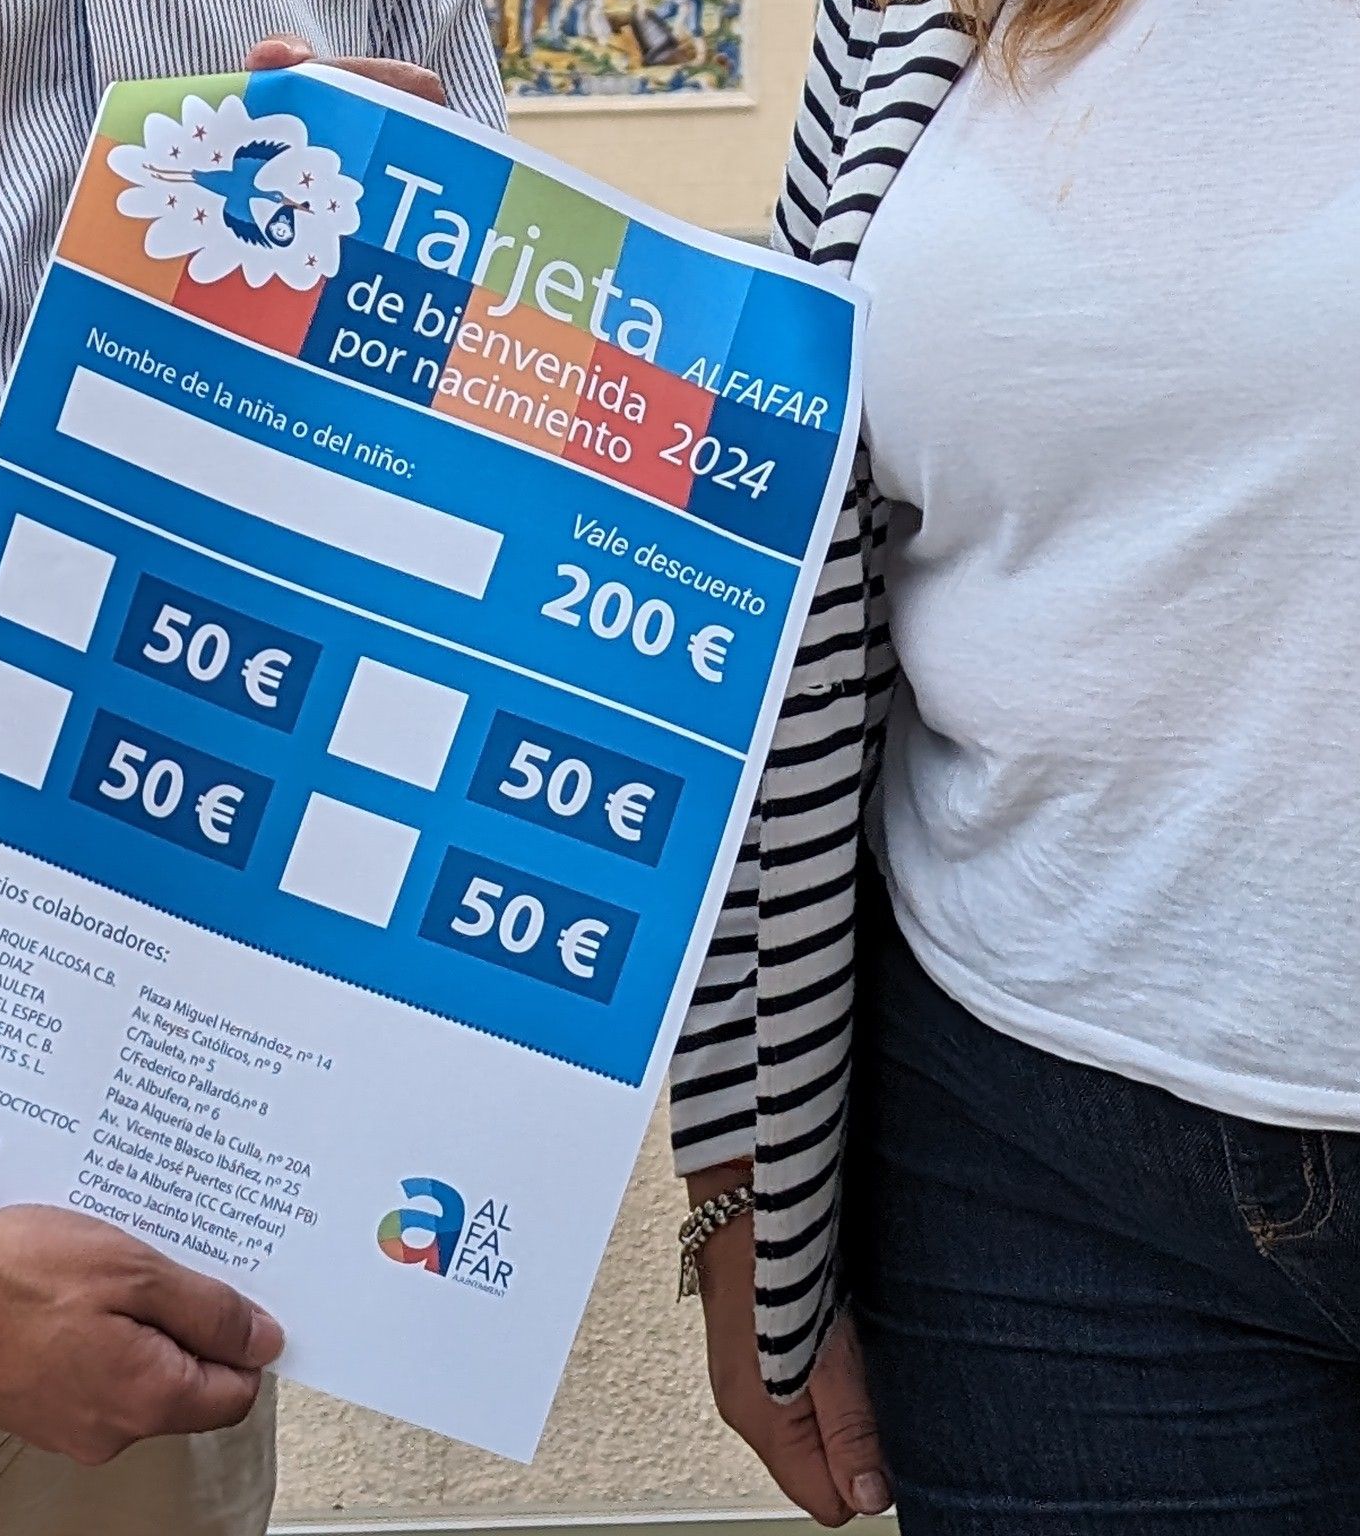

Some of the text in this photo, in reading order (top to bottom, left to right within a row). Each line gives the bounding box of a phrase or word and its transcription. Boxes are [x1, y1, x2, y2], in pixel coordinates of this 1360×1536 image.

[385, 164, 664, 363] Tarjeta
[347, 275, 647, 424] de bienvenida
[86, 327, 416, 479] Nombre de la niña o del niño:
[329, 326, 633, 464] por nacimiento
[682, 357, 829, 429] ALFAFAR
[659, 422, 777, 500] 2024
[574, 514, 766, 615] Vale descuento
[143, 604, 292, 707] 50 €
[541, 564, 735, 683] 200 €
[99, 740, 245, 844] 50 €
[499, 740, 655, 841] 50 €
[32, 895, 170, 963] colaboradores:
[39, 945, 91, 976] ALCOSA
[450, 877, 610, 978] 50 €
[11, 1004, 62, 1032] ESPEJO
[127, 1026, 186, 1063] C/Tauleta,
[206, 1059, 216, 1072] 5
[132, 1005, 150, 1024] Av.
[154, 1014, 189, 1039] Reyes
[192, 1030, 250, 1066] Católicos,
[272, 1061, 282, 1074] 9
[140, 985, 171, 1009] Plaza
[173, 999, 218, 1028] Miguel
[317, 1054, 332, 1070] 14
[106, 1086, 139, 1111] Plaza
[141, 1102, 193, 1132] Alquería
[195, 1124, 212, 1140] de
[214, 1129, 225, 1145] la
[114, 1067, 133, 1086] Av.
[136, 1077, 191, 1111] Albufera,
[211, 1107, 221, 1120] 6
[120, 1047, 186, 1083] C/Federico
[259, 1102, 268, 1116] 8
[84, 1149, 286, 1237] Av. de la Albufera (CC Carrefour)
[93, 1129, 154, 1163] C/Alcalde
[155, 1153, 184, 1174] José
[185, 1164, 232, 1194] Puertes
[235, 1184, 260, 1204] (CC
[99, 1108, 119, 1127] Av.
[127, 1117, 172, 1147] Vicente
[174, 1137, 214, 1163] Blasco
[283, 1180, 301, 1196] 25
[69, 1190, 130, 1223] C/Doctor
[132, 1212, 180, 1243] Ventura
[250, 1259, 260, 1272] 7
[79, 1170, 142, 1204] C/Párroco
[143, 1195, 189, 1223] Jacinto
[191, 1211, 238, 1242] Vicente
[264, 1243, 273, 1256] 4
[465, 1222, 499, 1256] FA
[474, 1199, 512, 1232] AL
[456, 1247, 513, 1289] FAR
